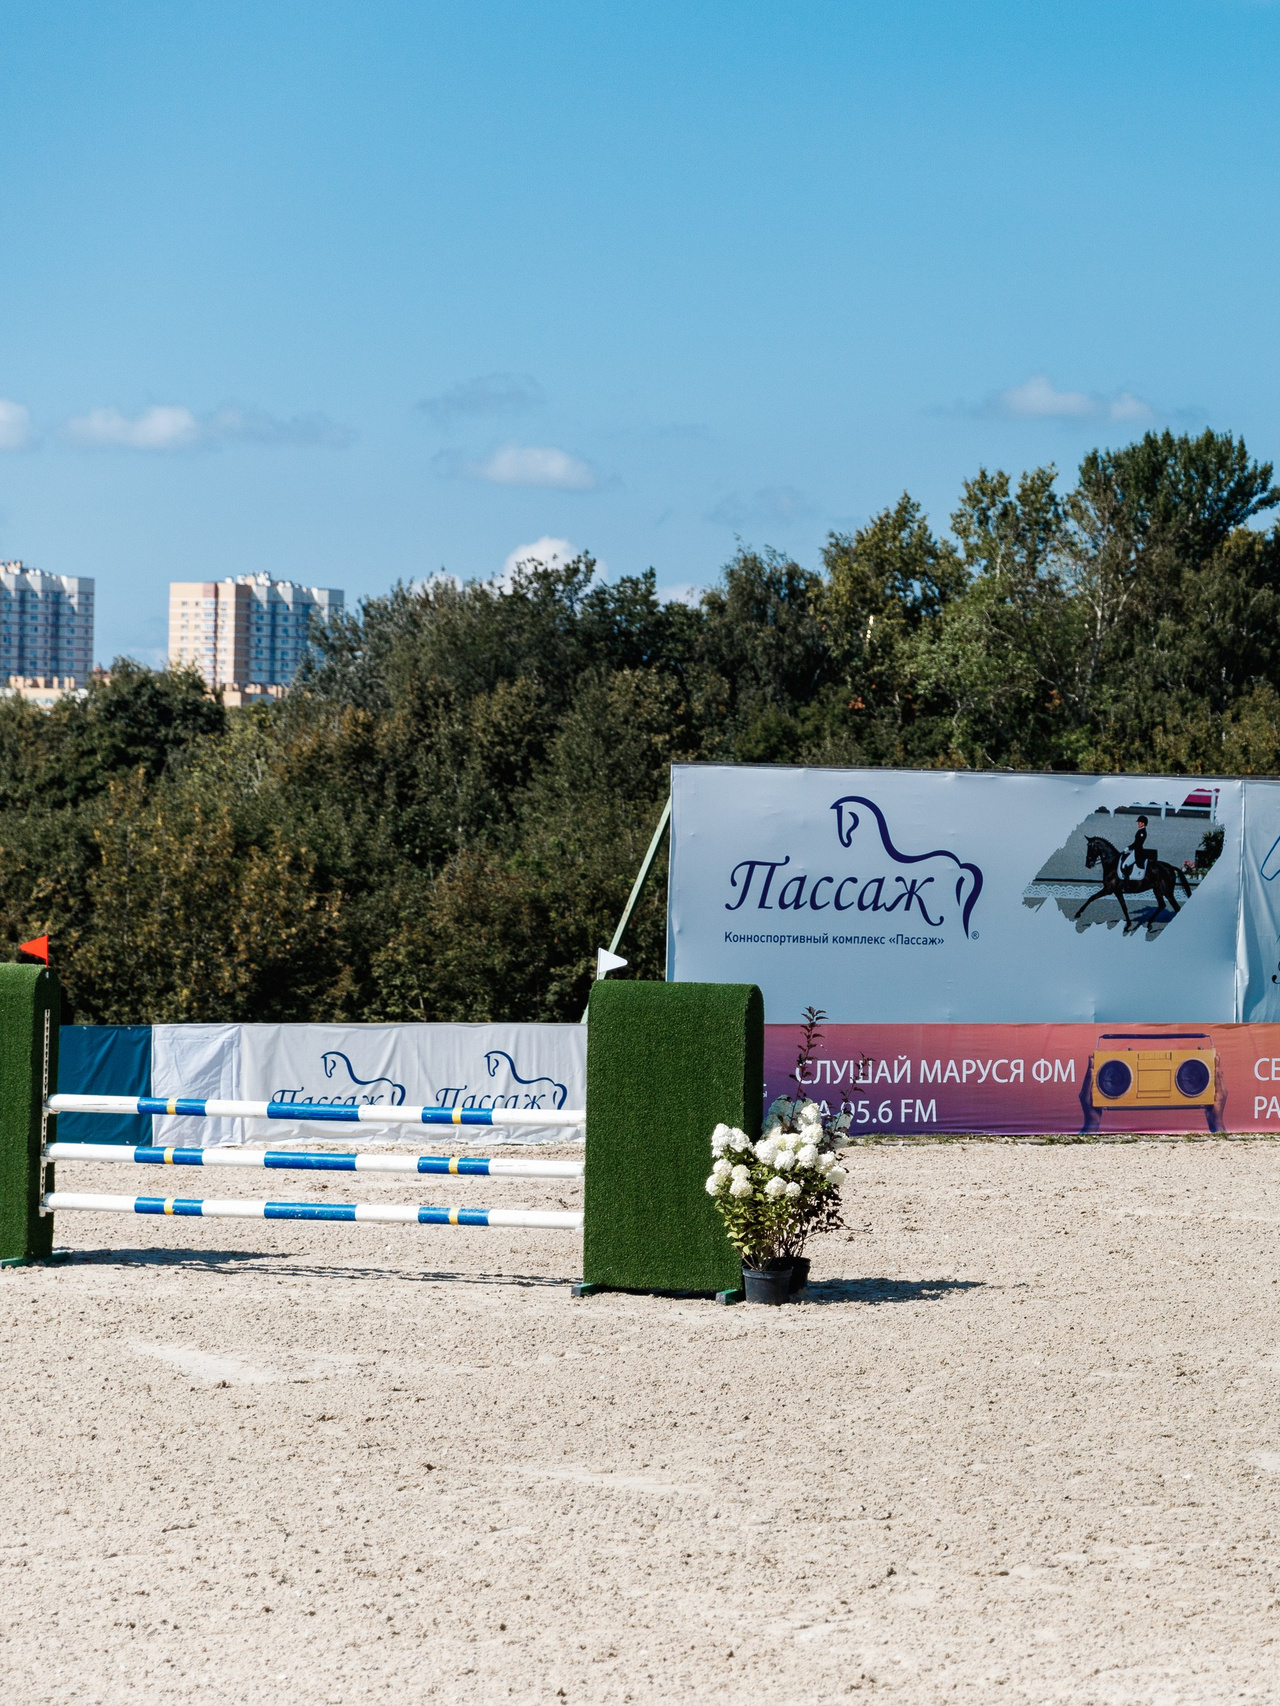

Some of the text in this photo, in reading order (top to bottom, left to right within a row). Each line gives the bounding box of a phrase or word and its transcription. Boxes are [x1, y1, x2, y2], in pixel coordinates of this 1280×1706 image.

[724, 855, 945, 927] Пассаж
[724, 931, 945, 946] Конноспортивный комплекс «Пассаж»
[795, 1055, 1076, 1085] СЛУШАЙ МАРУСЯ ФМ
[900, 1099, 938, 1123] FM
